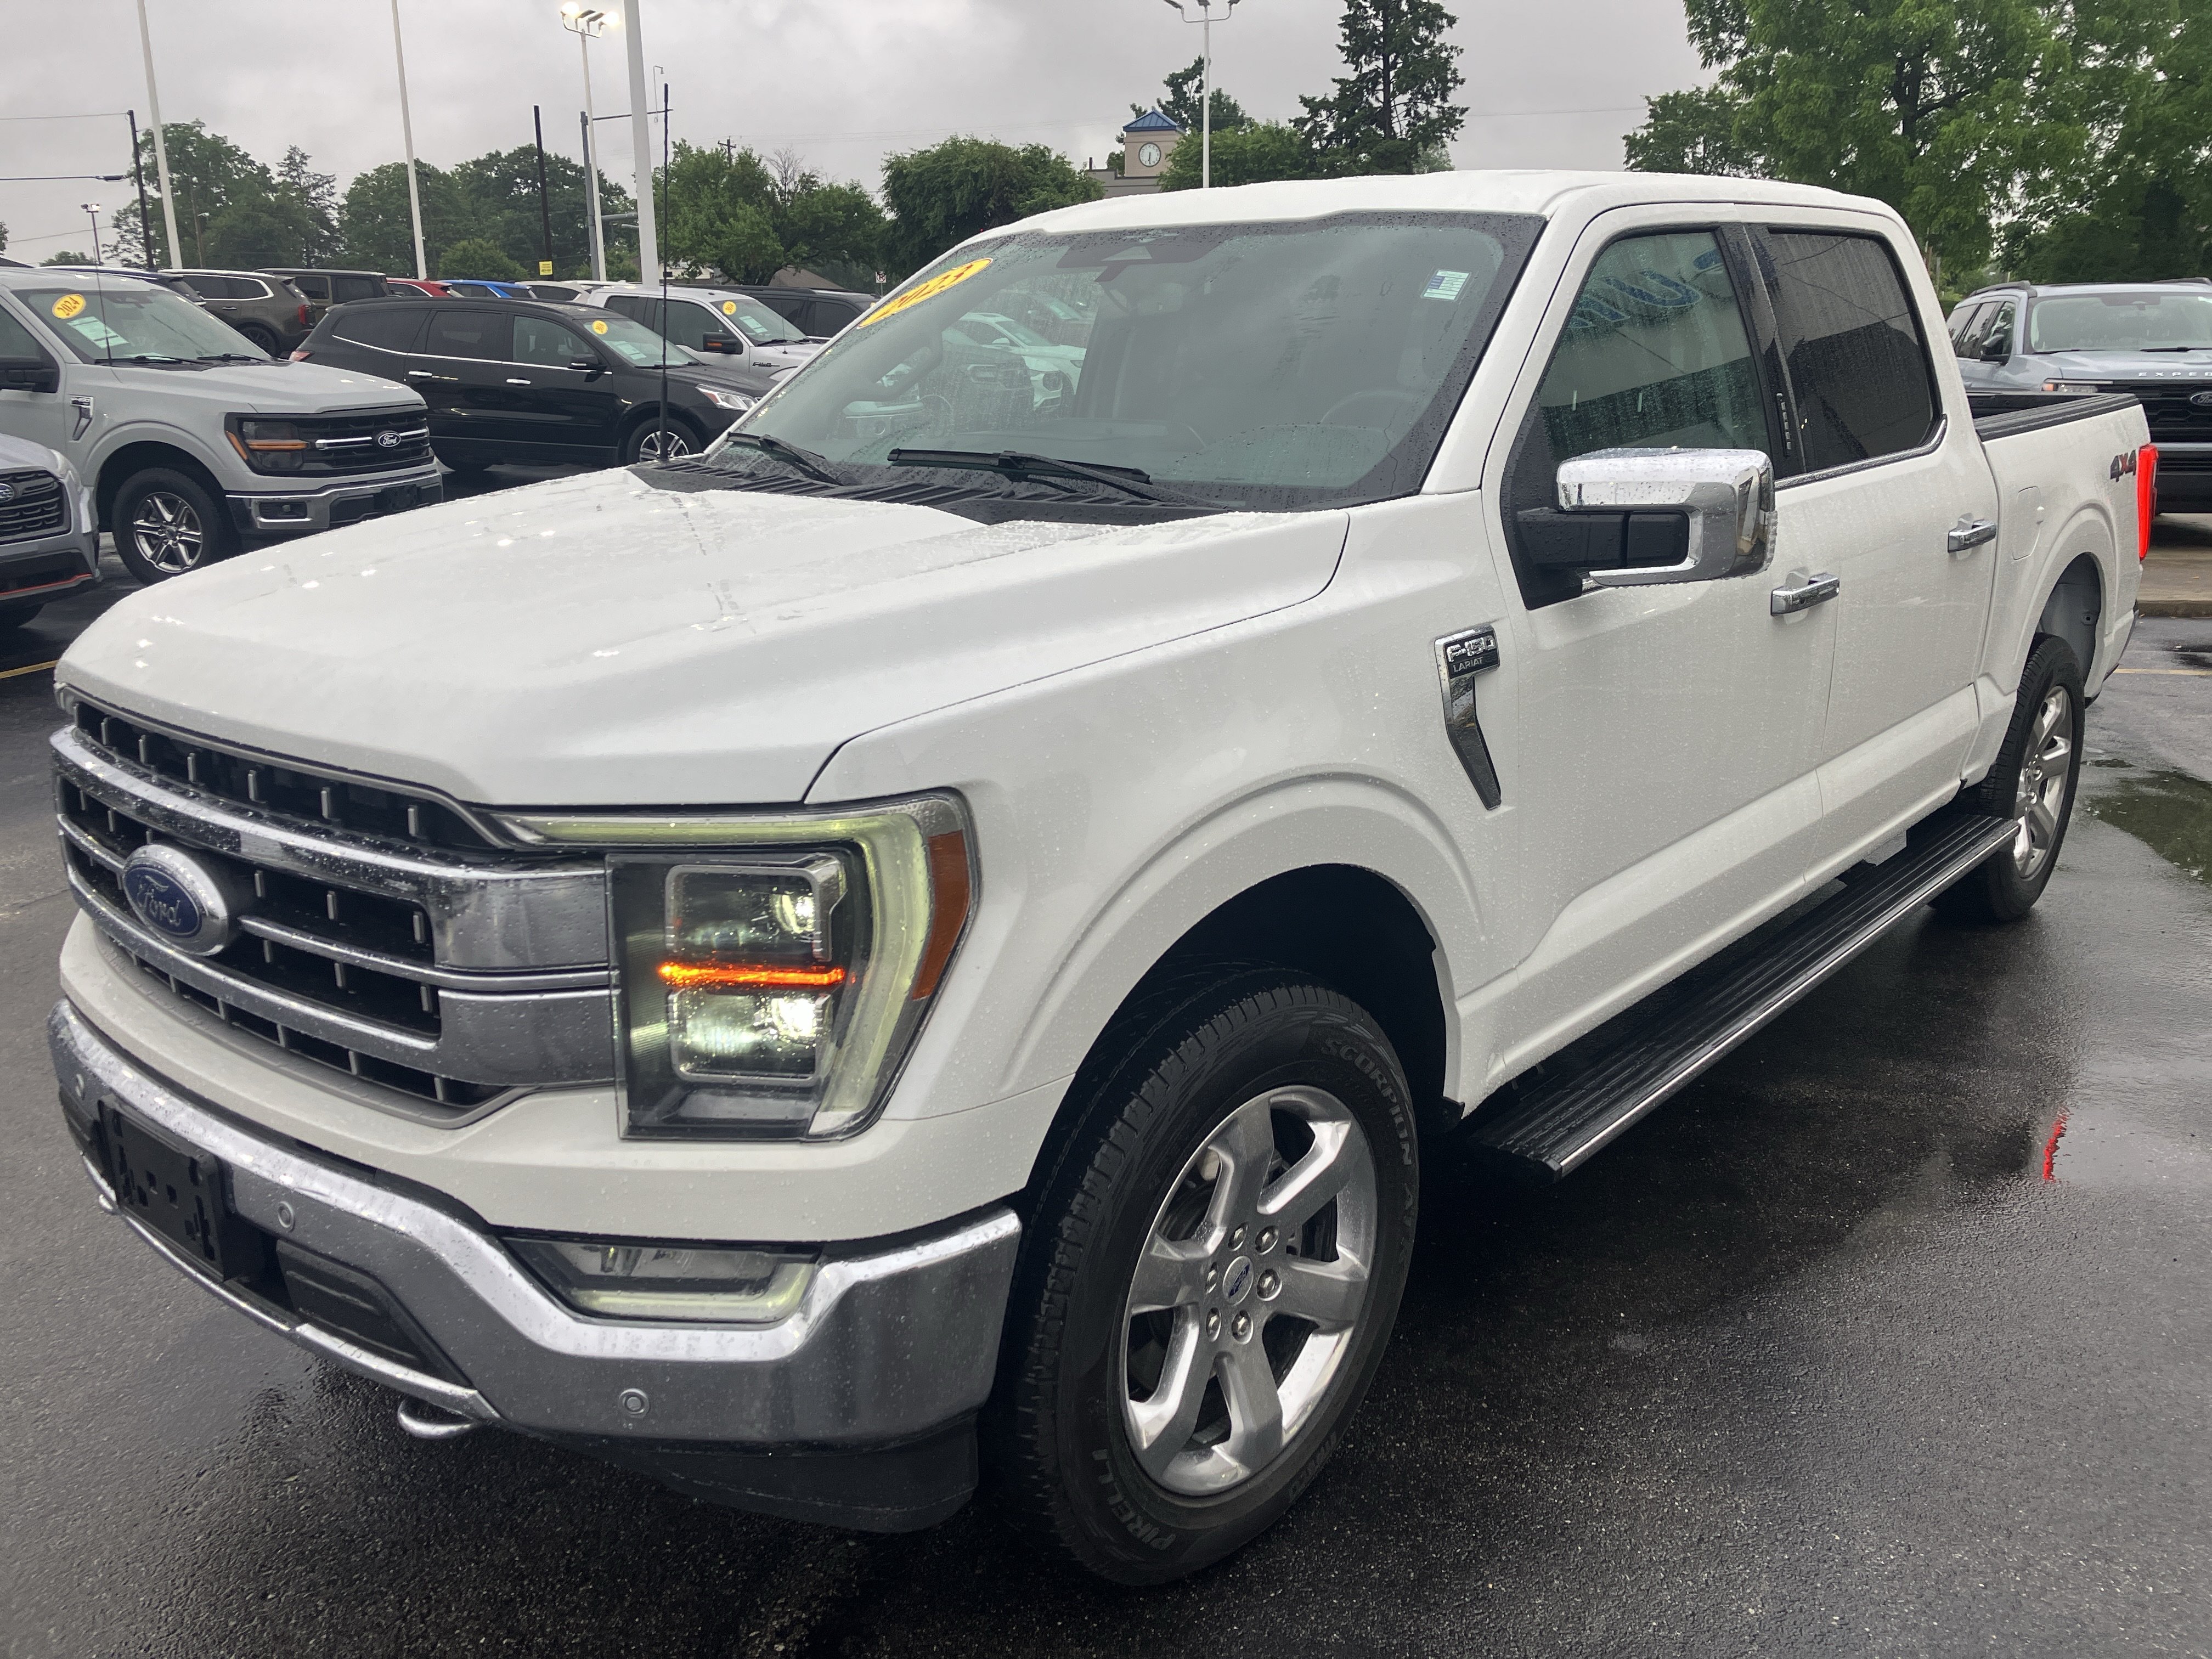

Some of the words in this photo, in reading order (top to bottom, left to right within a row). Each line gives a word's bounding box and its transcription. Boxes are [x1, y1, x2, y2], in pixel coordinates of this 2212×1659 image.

[57, 296, 80, 316] 2024
[383, 435, 397, 445] Ford
[1447, 635, 1496, 662] F-150
[1453, 656, 1483, 673] LARIAT
[137, 874, 182, 928] Ford
[1321, 1037, 1413, 1166] SCORPION
[1091, 1448, 1177, 1551] PIRELLI
